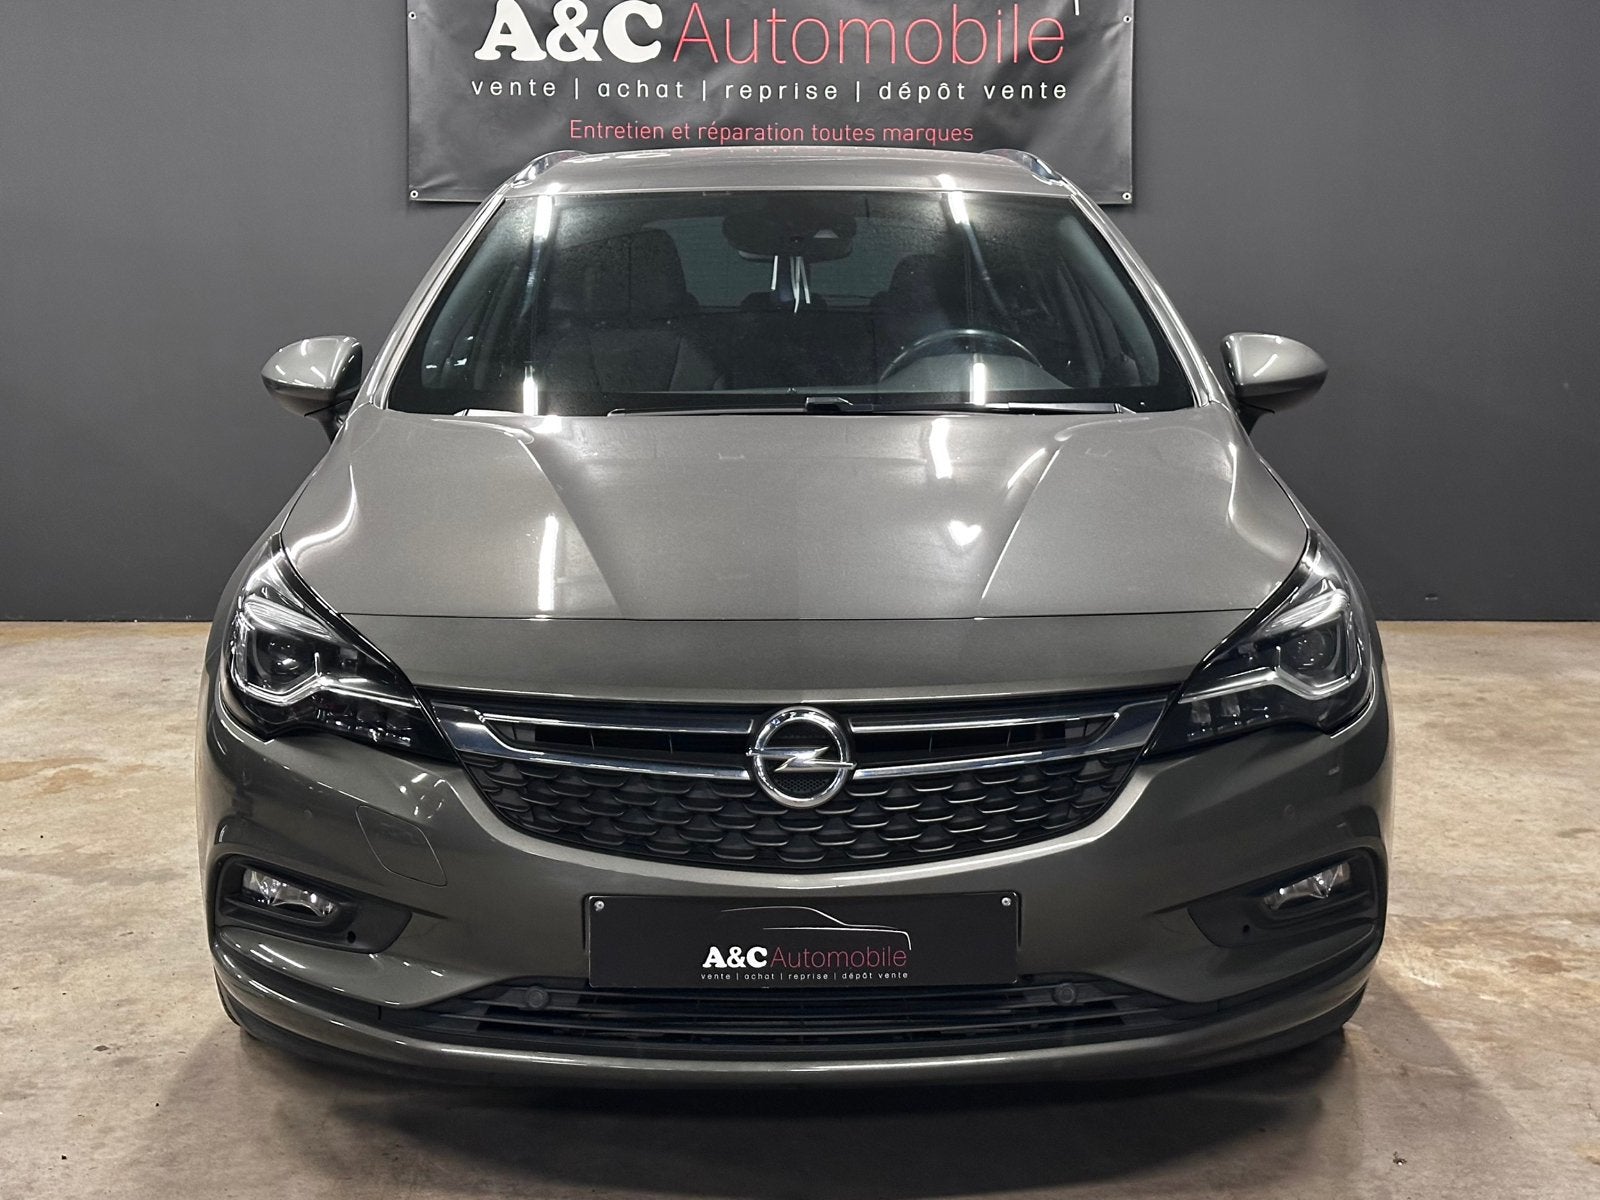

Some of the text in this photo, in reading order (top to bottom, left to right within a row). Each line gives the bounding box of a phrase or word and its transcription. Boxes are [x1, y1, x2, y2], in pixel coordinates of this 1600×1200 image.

[474, 0, 1066, 65] A&C Automobile
[471, 78, 556, 97] vente
[597, 79, 684, 99] achat
[725, 82, 838, 103] reprise
[878, 81, 966, 104] dépôt
[983, 82, 1067, 100] vente
[569, 119, 974, 146] Entretien et réparation toutes marques
[702, 946, 907, 969] A&C Automobile
[700, 973, 731, 981] vente
[744, 972, 775, 981] achat
[788, 972, 829, 981] reprise
[878, 971, 908, 980] vente
